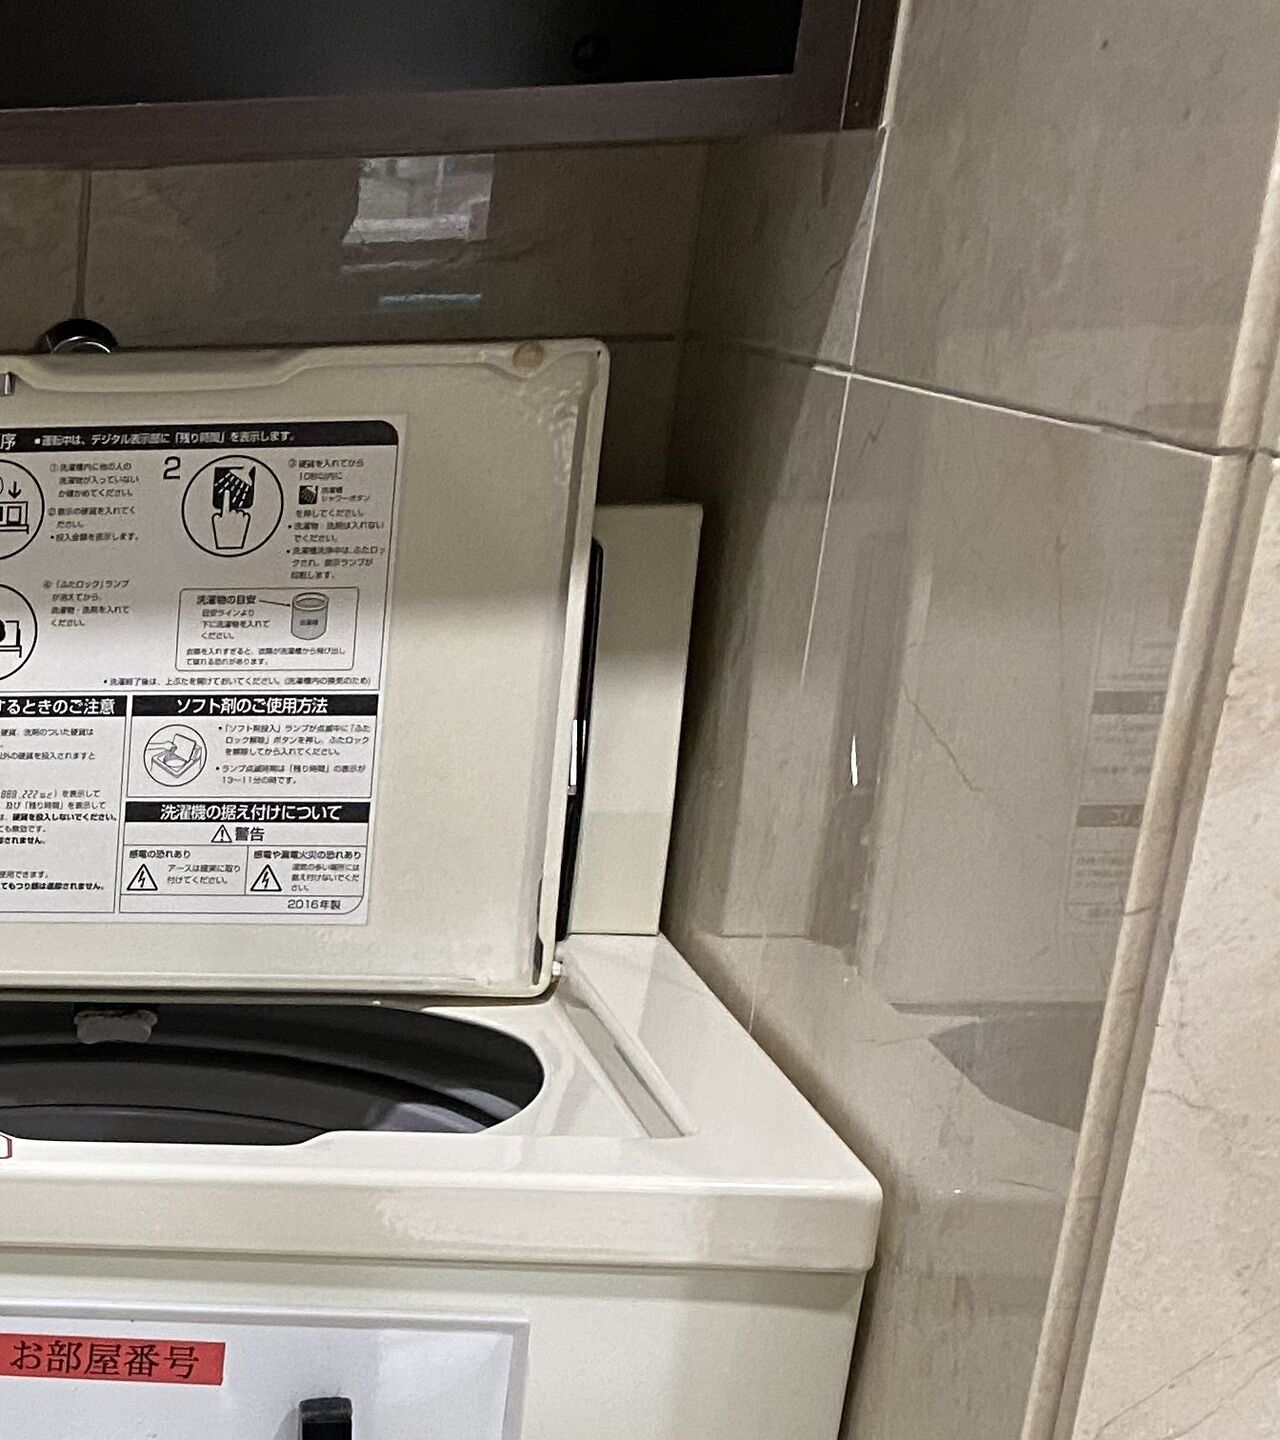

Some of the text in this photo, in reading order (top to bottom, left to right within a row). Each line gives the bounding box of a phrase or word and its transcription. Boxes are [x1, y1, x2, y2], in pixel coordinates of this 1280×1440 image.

[163, 456, 181, 480] 2
[176, 697, 329, 715] ソフト剤のご使用方法
[159, 805, 342, 821] 洗濯機の据え付けについて
[235, 826, 266, 842] 警告
[287, 899, 341, 910] 2016年製
[9, 1339, 200, 1379] お部屋番号
